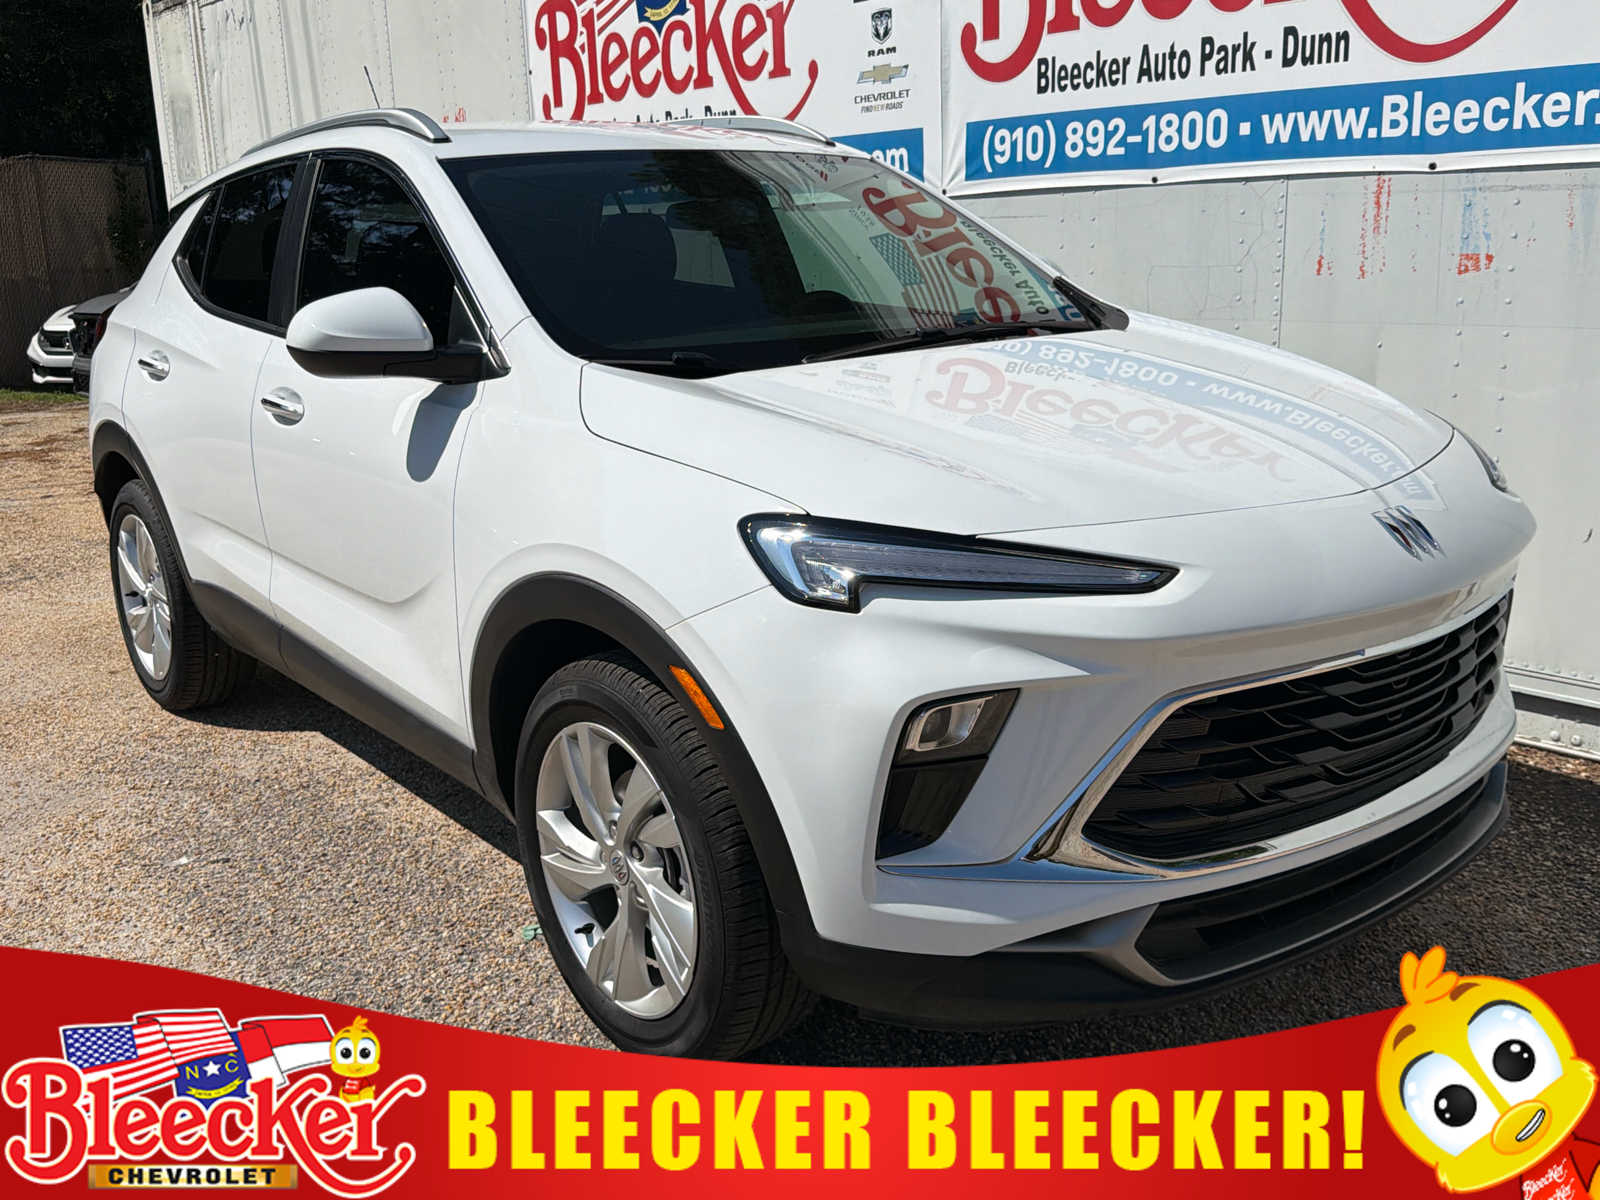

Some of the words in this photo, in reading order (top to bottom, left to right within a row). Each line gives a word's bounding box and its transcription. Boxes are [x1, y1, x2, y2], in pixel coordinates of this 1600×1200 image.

[536, 0, 818, 120] Bleecker
[867, 47, 897, 57] RAM
[1036, 51, 1131, 95] Bleecker
[1137, 42, 1191, 84] Auto
[1199, 31, 1257, 77] Park
[1281, 25, 1351, 68] Dunn
[854, 89, 911, 105] CHEVROLET
[983, 119, 1057, 173] (910)
[1064, 108, 1229, 158] 892-1800
